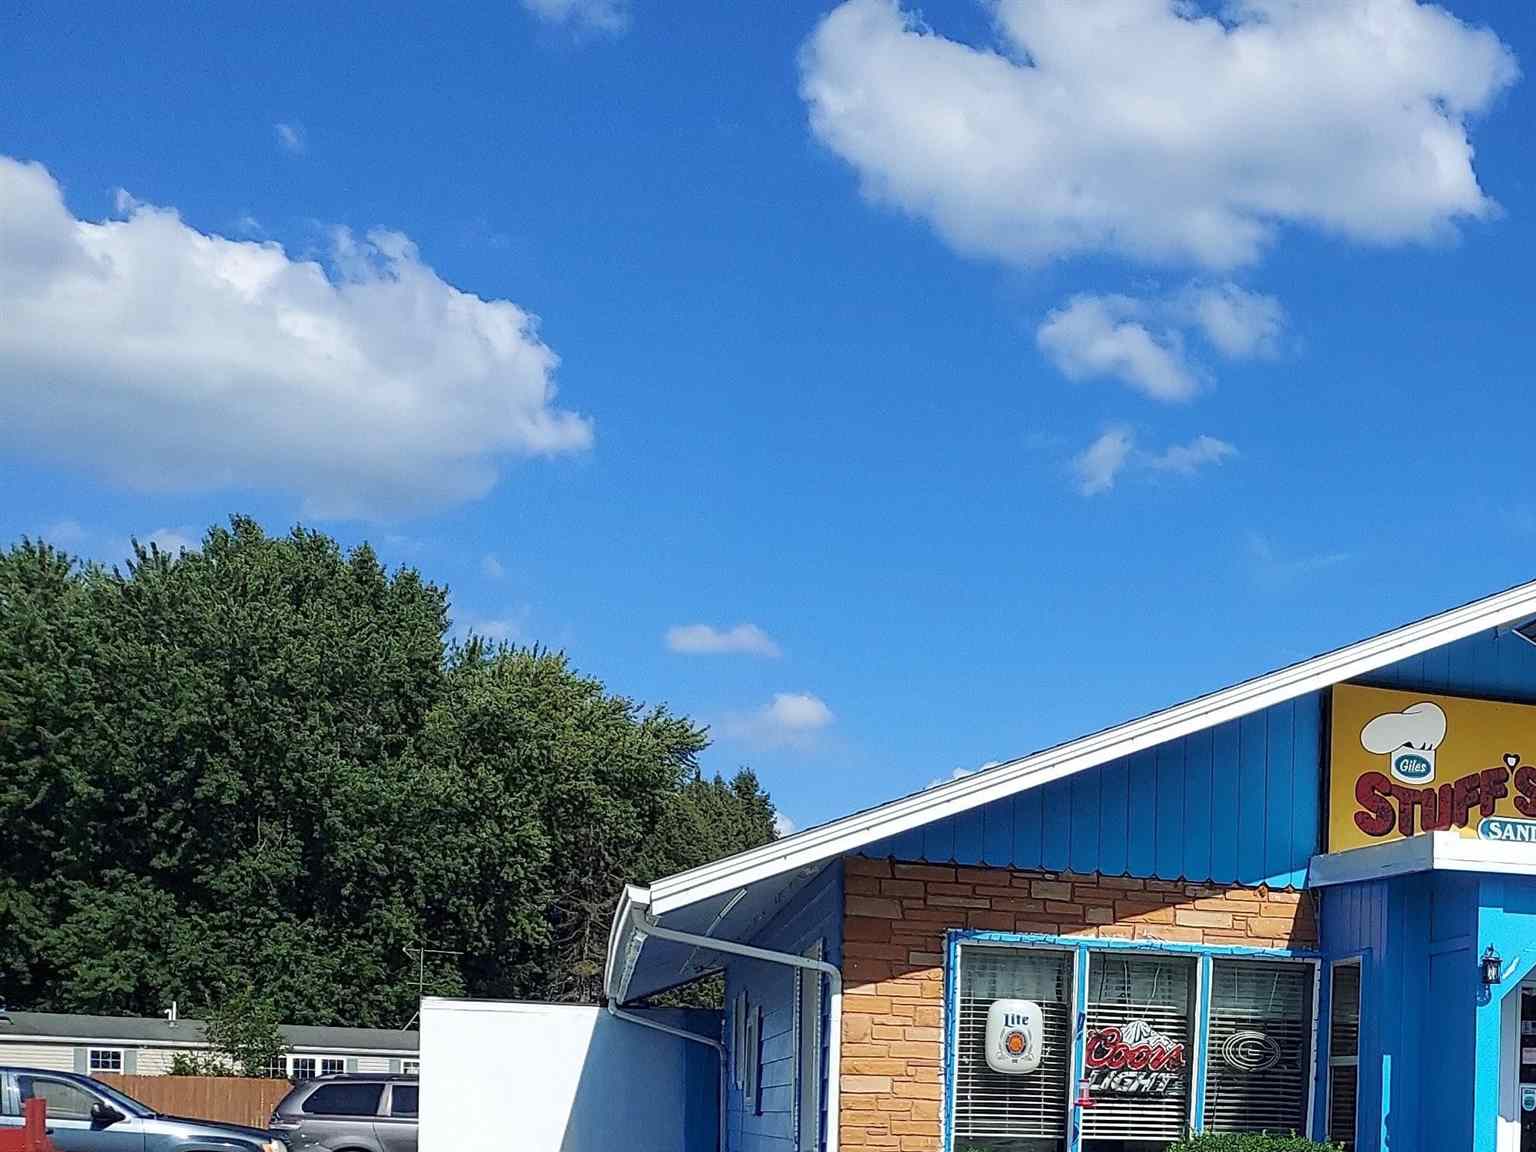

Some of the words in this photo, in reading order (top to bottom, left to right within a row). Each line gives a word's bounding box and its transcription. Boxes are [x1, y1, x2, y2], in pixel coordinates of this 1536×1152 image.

[1399, 758, 1427, 773] Giles
[1004, 1013, 1030, 1028] Lite
[1086, 1026, 1185, 1071] Coors
[1087, 1070, 1180, 1093] LIGHT
